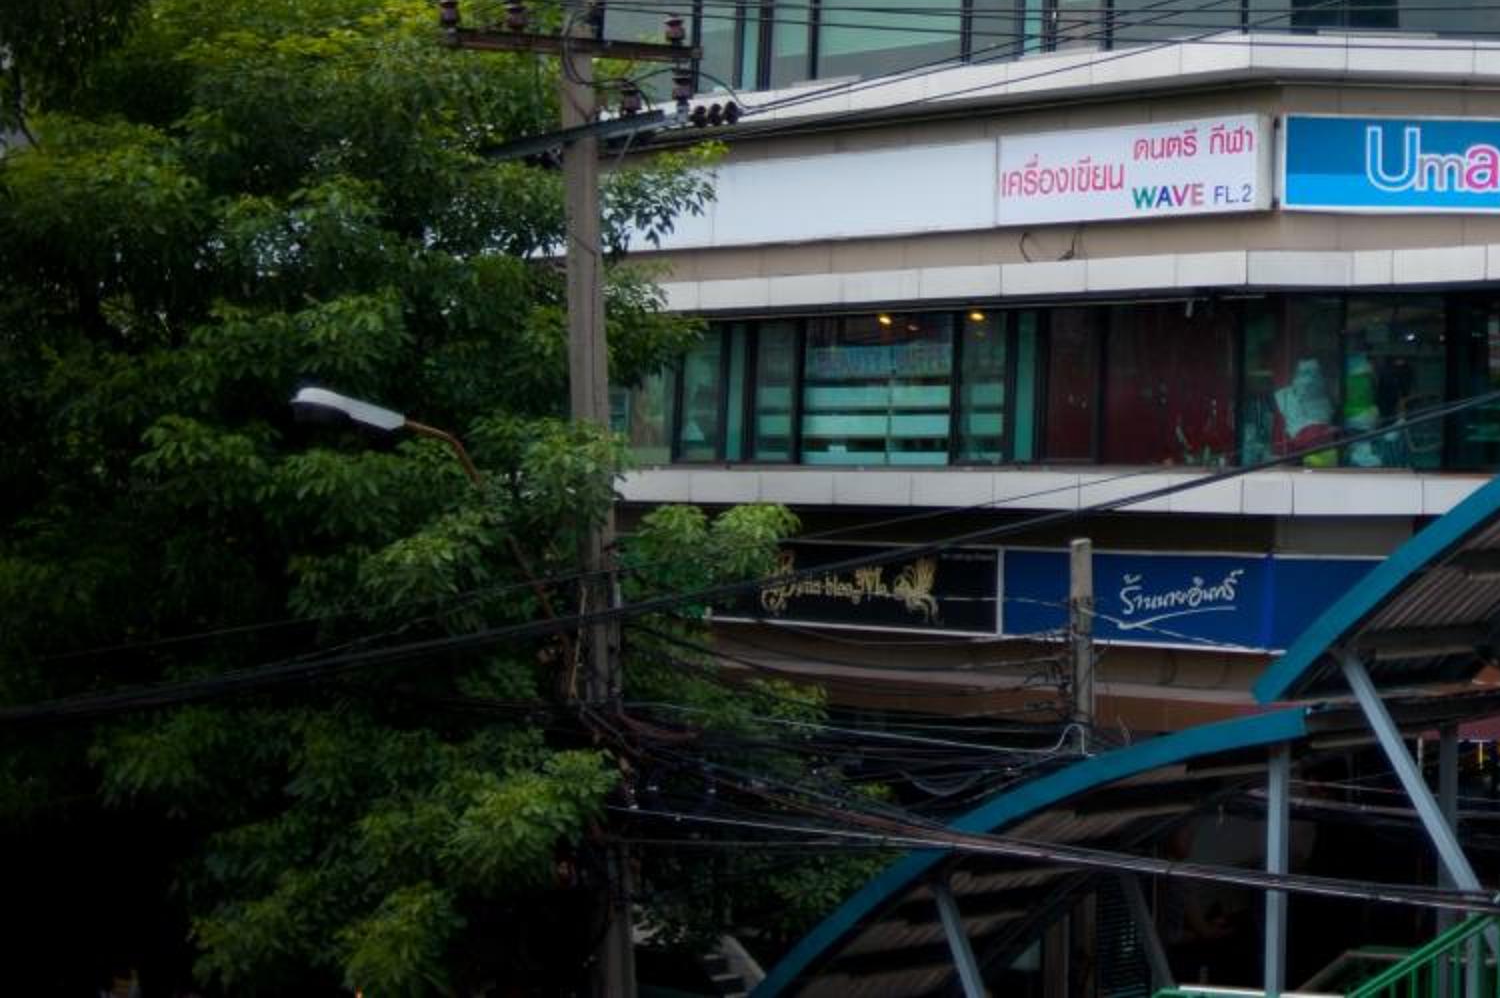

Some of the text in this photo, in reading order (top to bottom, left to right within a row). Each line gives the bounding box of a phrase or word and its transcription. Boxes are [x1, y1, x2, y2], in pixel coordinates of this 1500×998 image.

[1133, 122, 1254, 160] ดนตรี กีฬา
[1001, 153, 1125, 198] เครื่องเขียน
[1132, 183, 1205, 210] WAVE
